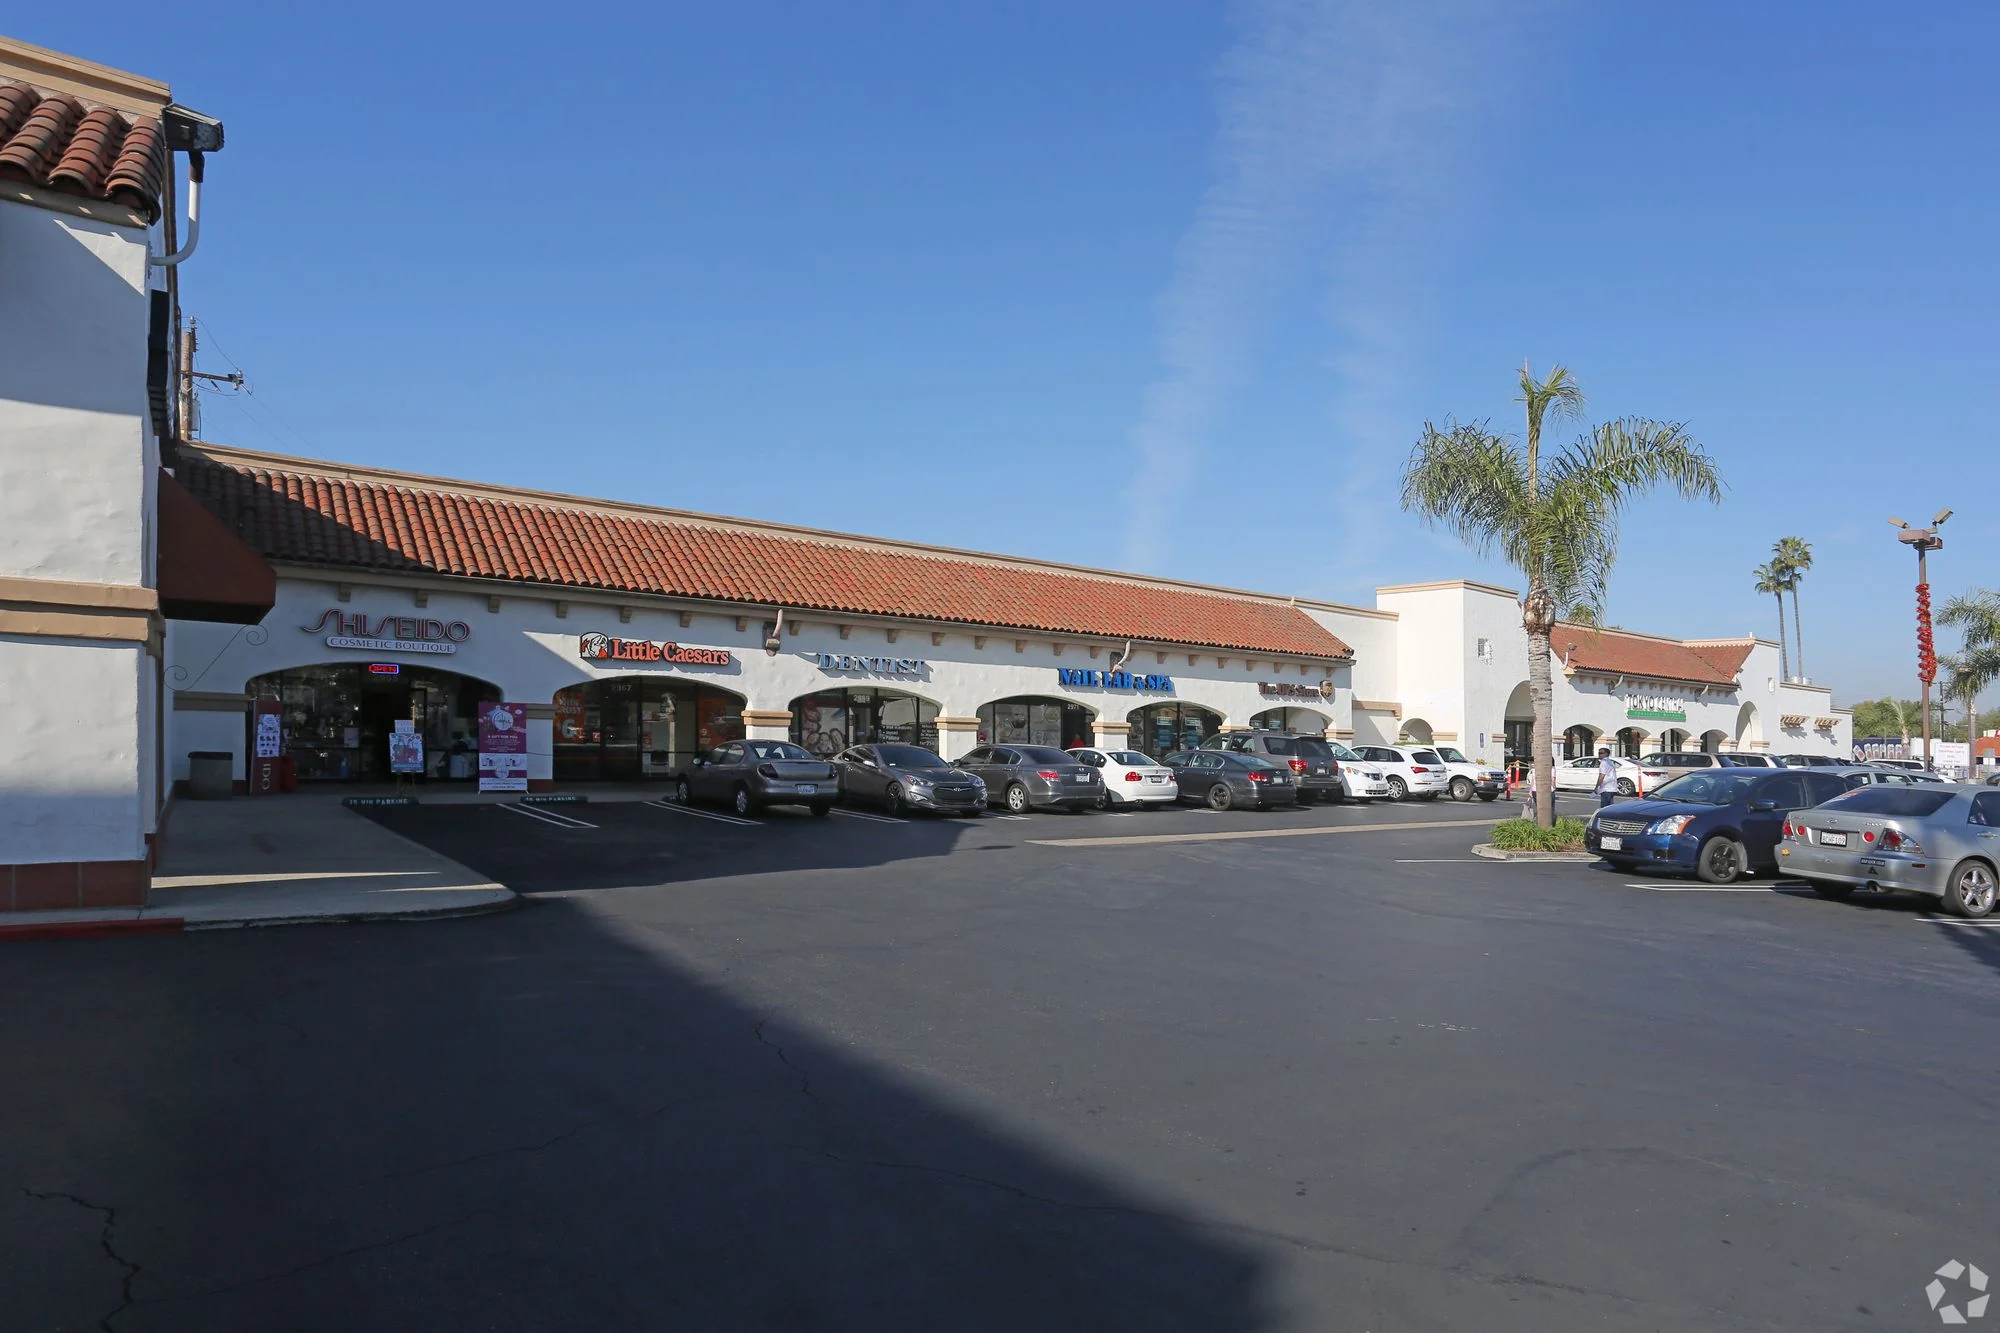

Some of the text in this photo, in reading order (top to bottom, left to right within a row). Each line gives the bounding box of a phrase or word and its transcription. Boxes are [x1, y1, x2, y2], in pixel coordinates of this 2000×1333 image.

[300, 608, 471, 642] SHISEIDO
[330, 638, 453, 652] COSMETIC BOUTIQUE
[611, 638, 730, 666] Little Caesars
[368, 664, 397, 674] OPEN
[818, 652, 926, 674] DENTIST
[1058, 668, 1173, 692] NAIL LAB & SPA
[1258, 682, 1276, 694] The
[1276, 683, 1295, 696] UPS
[1296, 684, 1320, 698] Store
[1625, 694, 1654, 710] TOKYO
